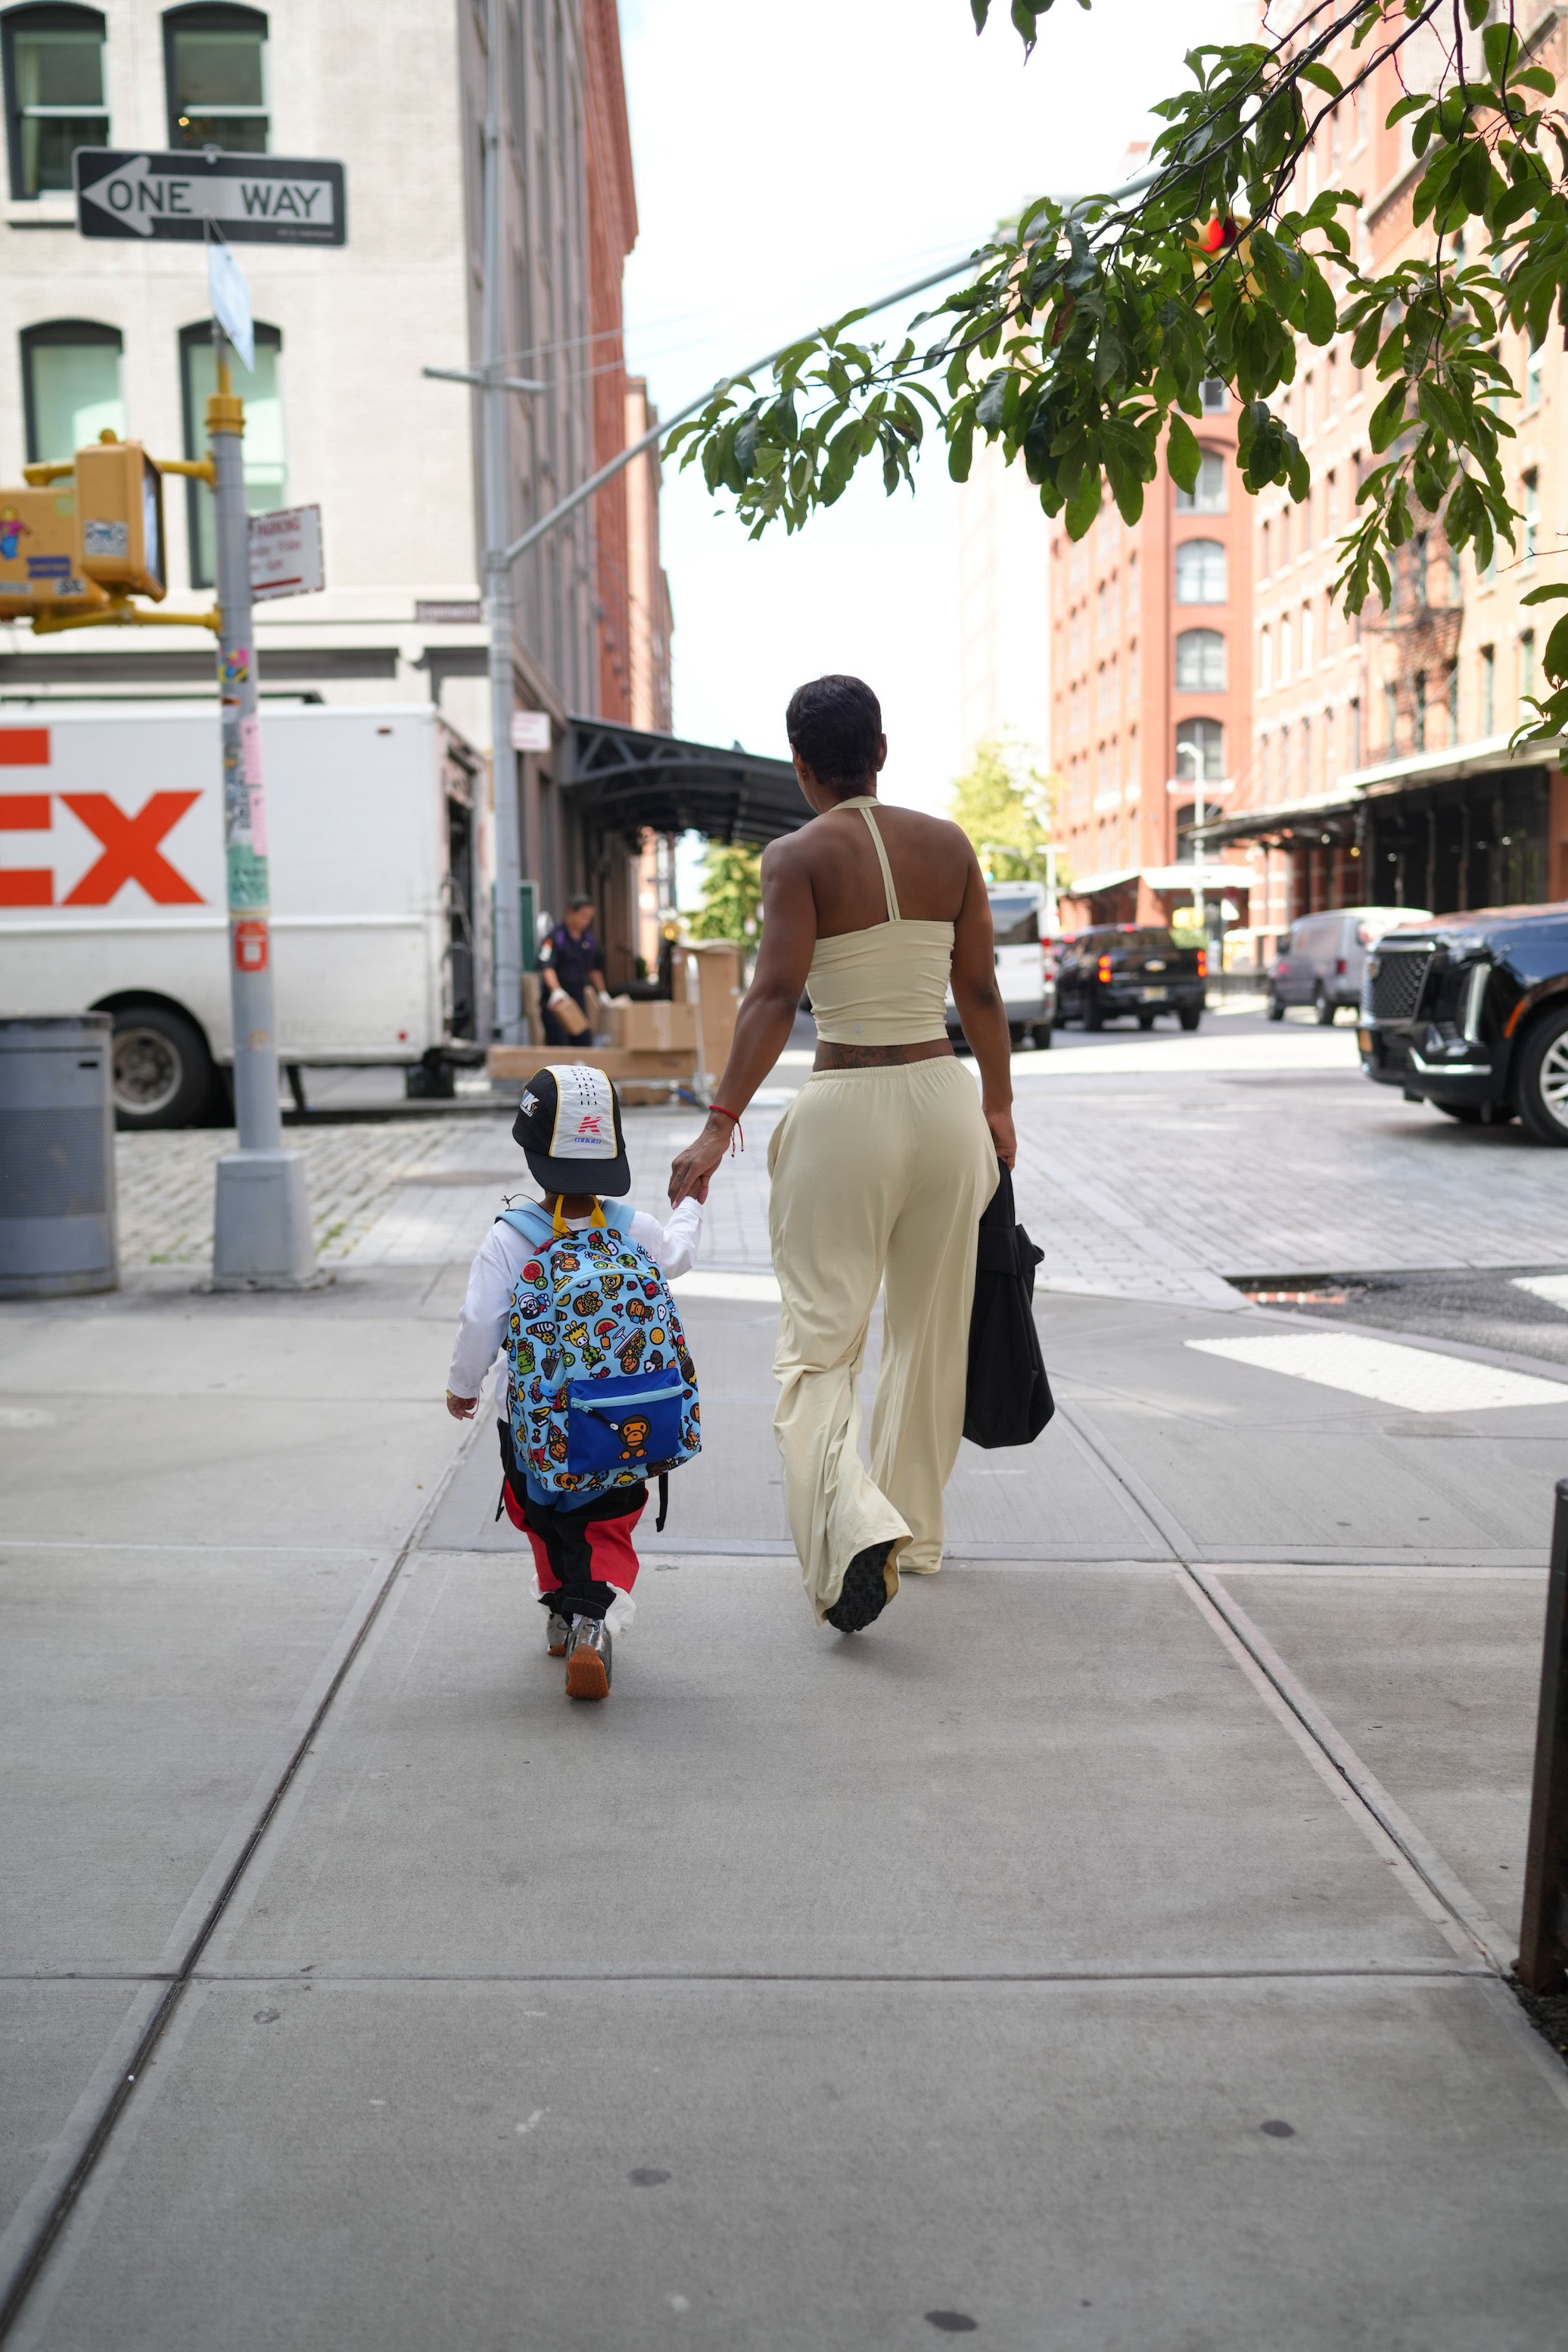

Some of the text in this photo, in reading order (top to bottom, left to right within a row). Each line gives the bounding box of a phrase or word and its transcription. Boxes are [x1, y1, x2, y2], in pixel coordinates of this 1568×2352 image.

[107, 179, 321, 218] ONE WAY
[577, 1116, 604, 1135] K
